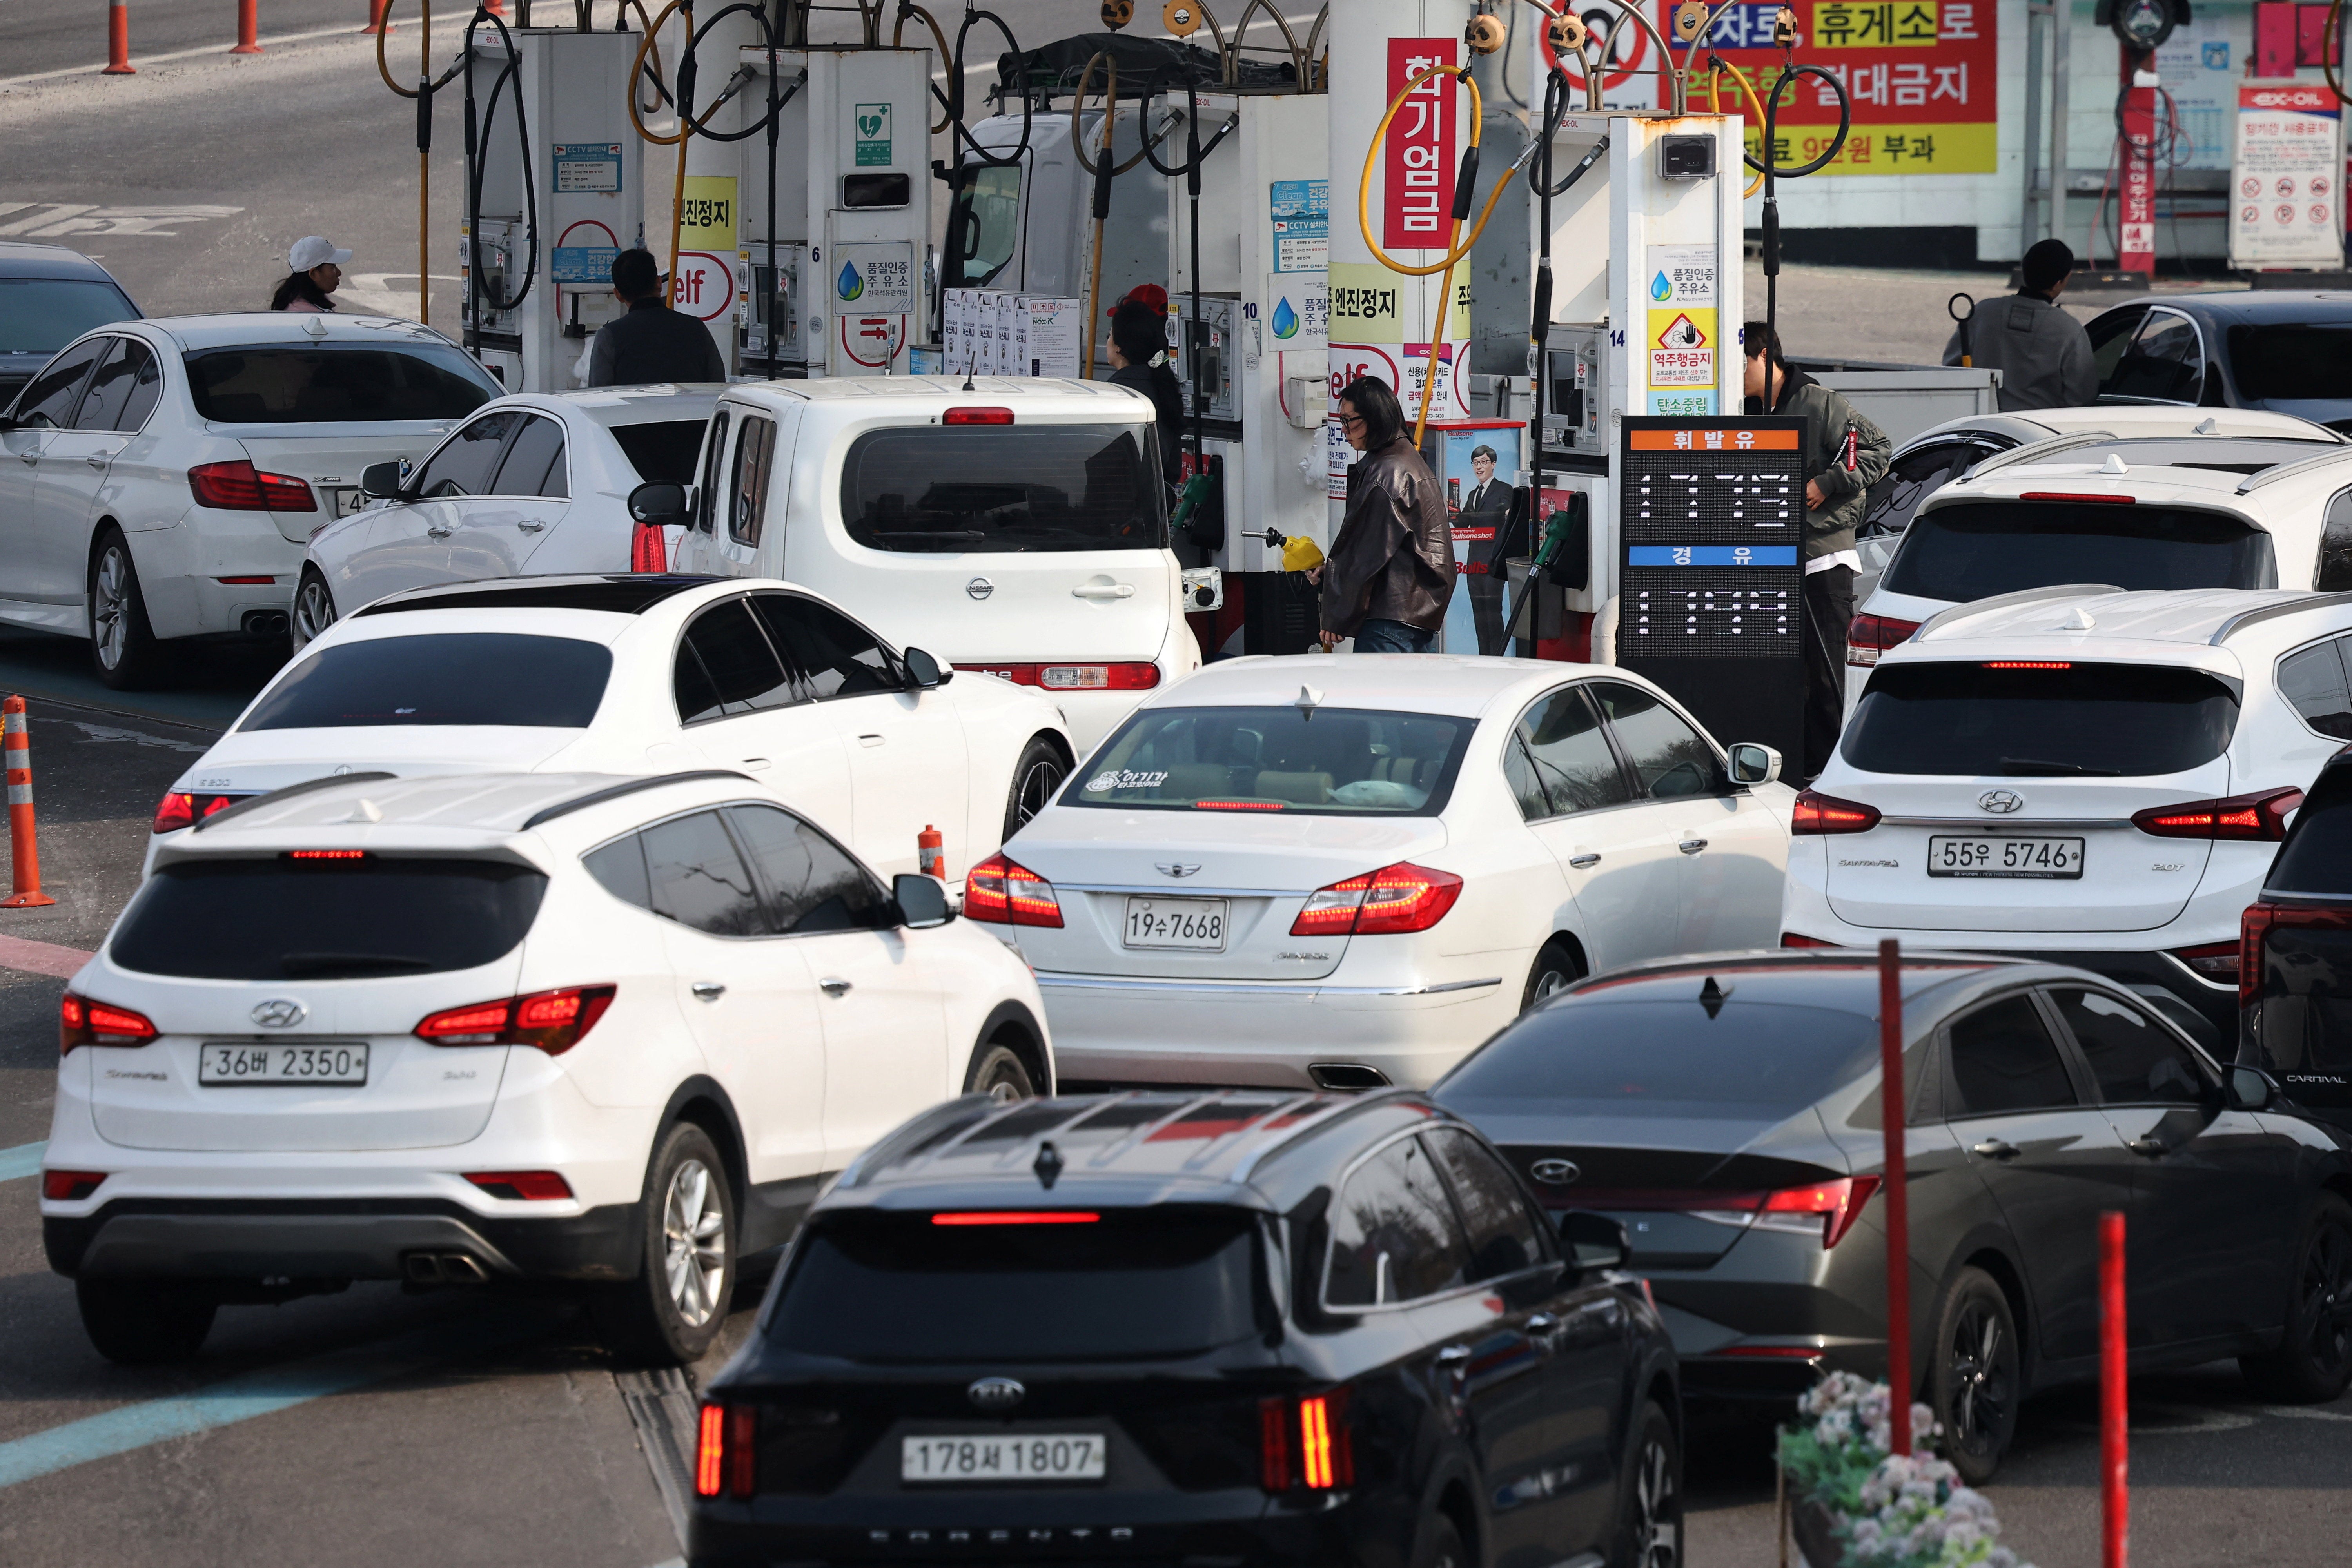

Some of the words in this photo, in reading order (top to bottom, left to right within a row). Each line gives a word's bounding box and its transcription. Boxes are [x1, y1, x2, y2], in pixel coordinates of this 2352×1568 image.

[1818, 3, 1979, 45] 휴게소로
[1687, 65, 1797, 107] 역주행
[1812, 60, 1968, 106] 절대금지
[1402, 55, 1445, 232] 화기엄금
[1803, 137, 1872, 163] 9만원
[1883, 135, 1936, 163] 부과
[1277, 192, 1304, 200] Clean
[588, 255, 617, 265] 건강한
[812, 247, 820, 262] 6
[867, 262, 908, 274] 품질인증
[1673, 269, 1715, 281] 품질인증
[1678, 283, 1709, 294] 주유소
[1304, 298, 1327, 311] 품질
[1335, 287, 1396, 319] 엔진정지
[1243, 303, 1258, 319] 10
[1610, 330, 1625, 347] 14
[1654, 353, 1710, 367] 역주행금지
[1408, 367, 1448, 377] 신용()카드
[1328, 363, 1369, 400] elf
[1432, 379, 1443, 389] 오류
[1408, 391, 1433, 401] 금액
[1436, 391, 1447, 401] 안내
[1657, 397, 1706, 412] 탄소중립
[1335, 452, 1348, 460] 전체가
[1122, 771, 1169, 782] 아기가
[1944, 843, 1990, 867] 55우
[2003, 843, 2068, 868] 5746
[1131, 912, 1221, 939] 19수7668
[1277, 951, 1329, 960] GENESIS
[215, 1049, 268, 1077] 36버
[281, 1049, 351, 1076] 2350
[2287, 1074, 2347, 1084] CARNIVAL
